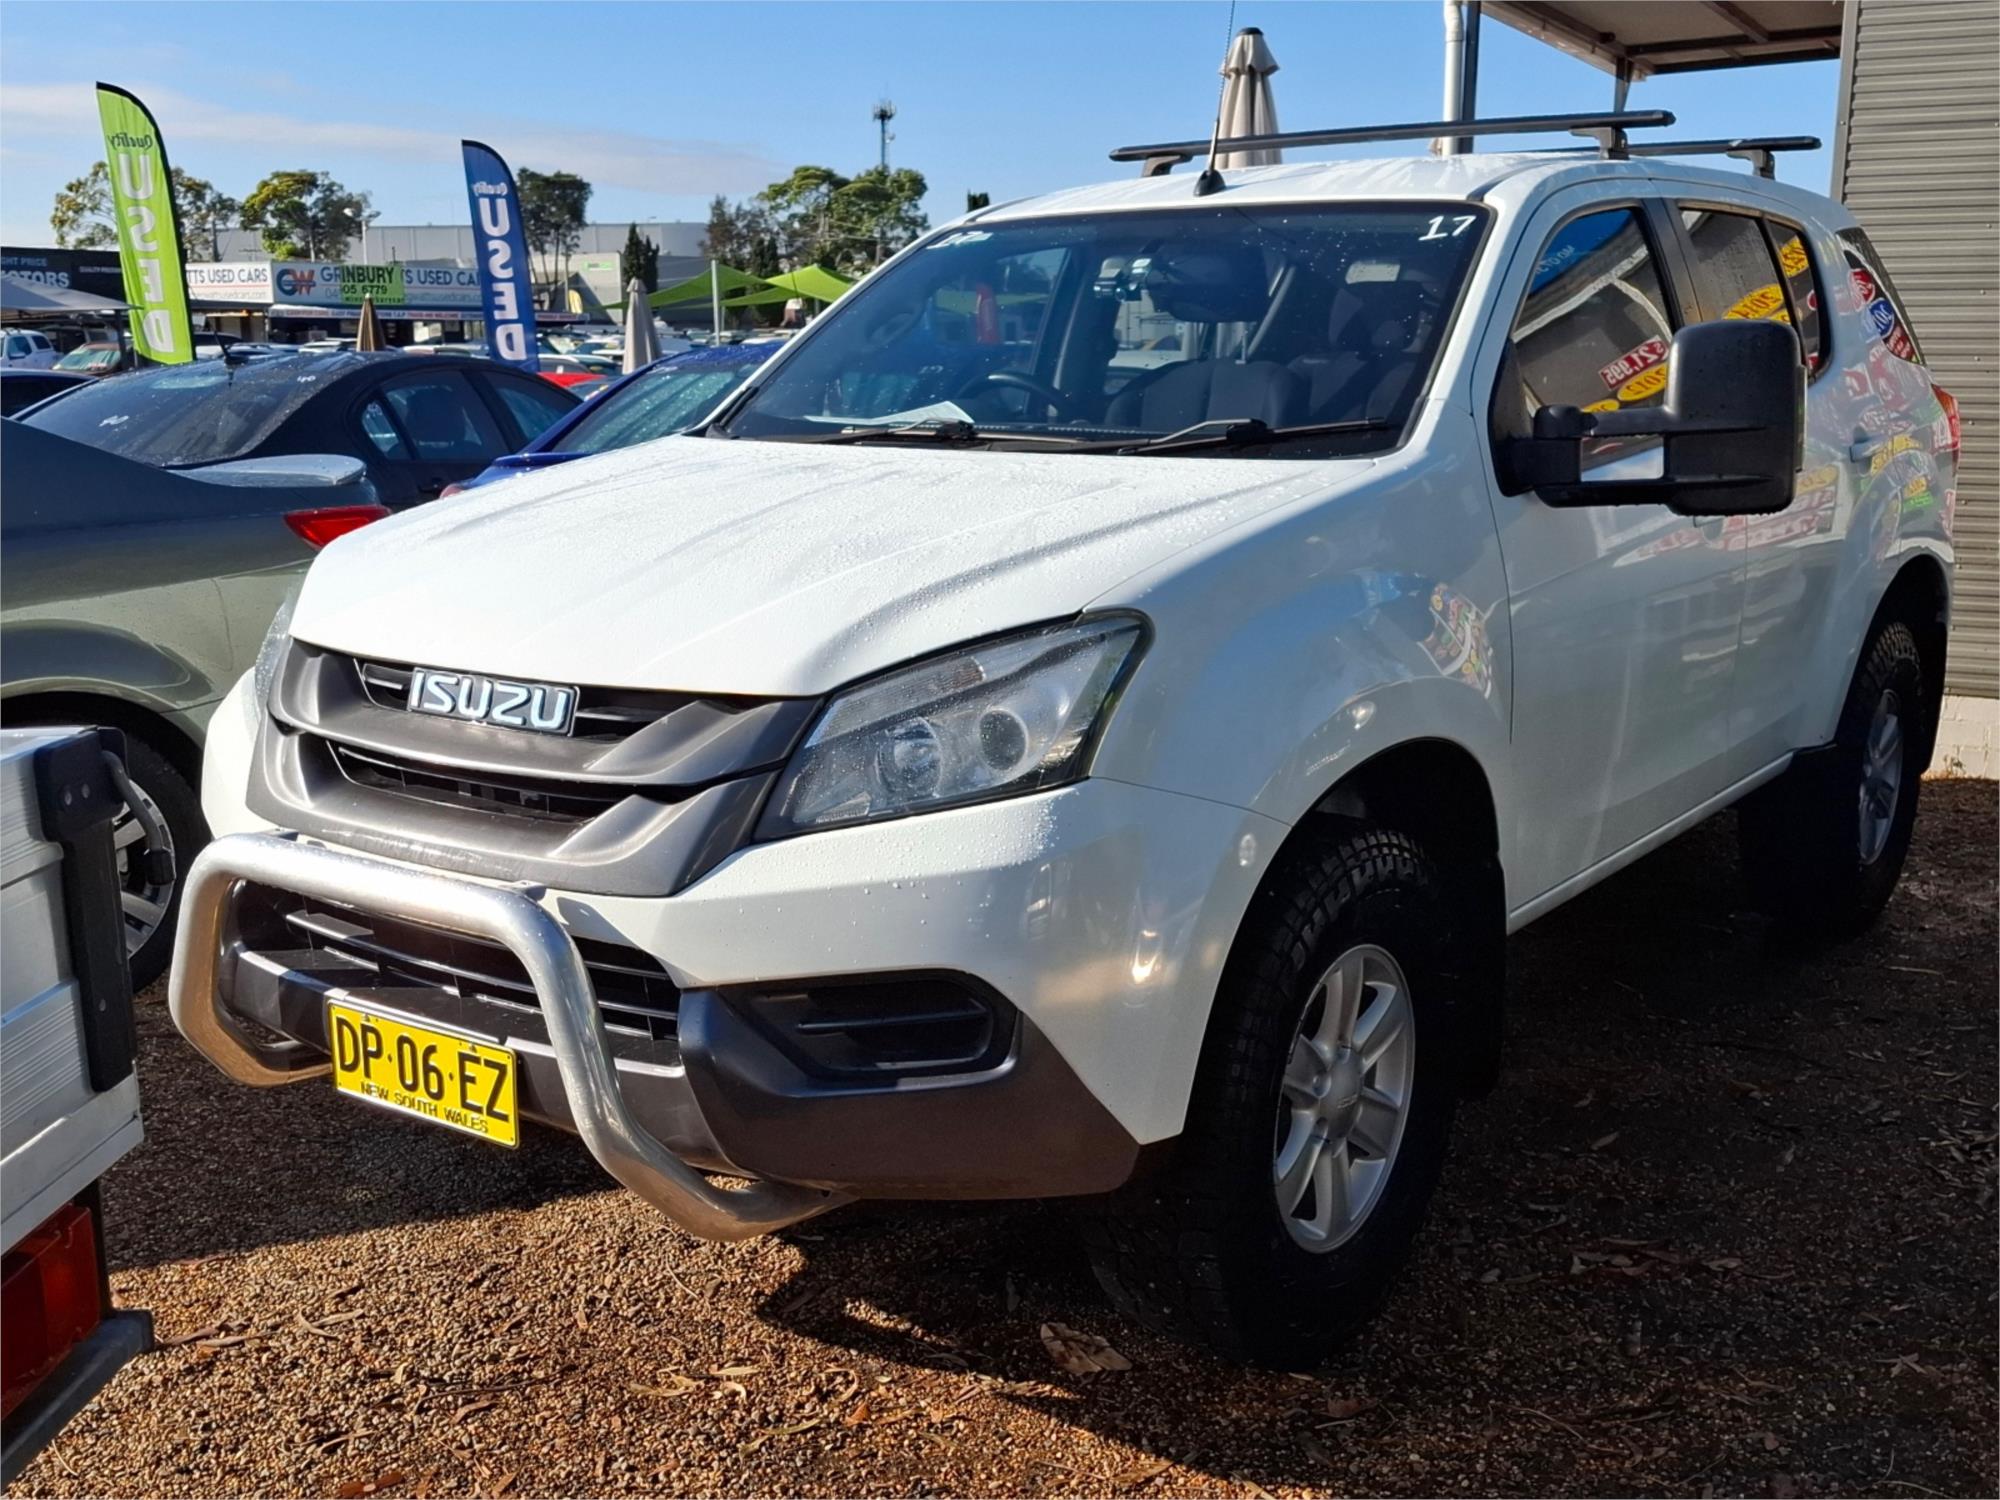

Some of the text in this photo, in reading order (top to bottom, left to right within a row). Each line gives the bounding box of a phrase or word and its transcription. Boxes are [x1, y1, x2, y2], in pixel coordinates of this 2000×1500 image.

[1418, 214, 1476, 241] 17
[1, 256, 19, 265] GHT
[208, 268, 235, 284] USED
[238, 268, 268, 282] CARS
[417, 270, 453, 286] USED
[410, 671, 568, 730] ISUZU
[360, 1080, 489, 1134] NEW SOUTH WALES
